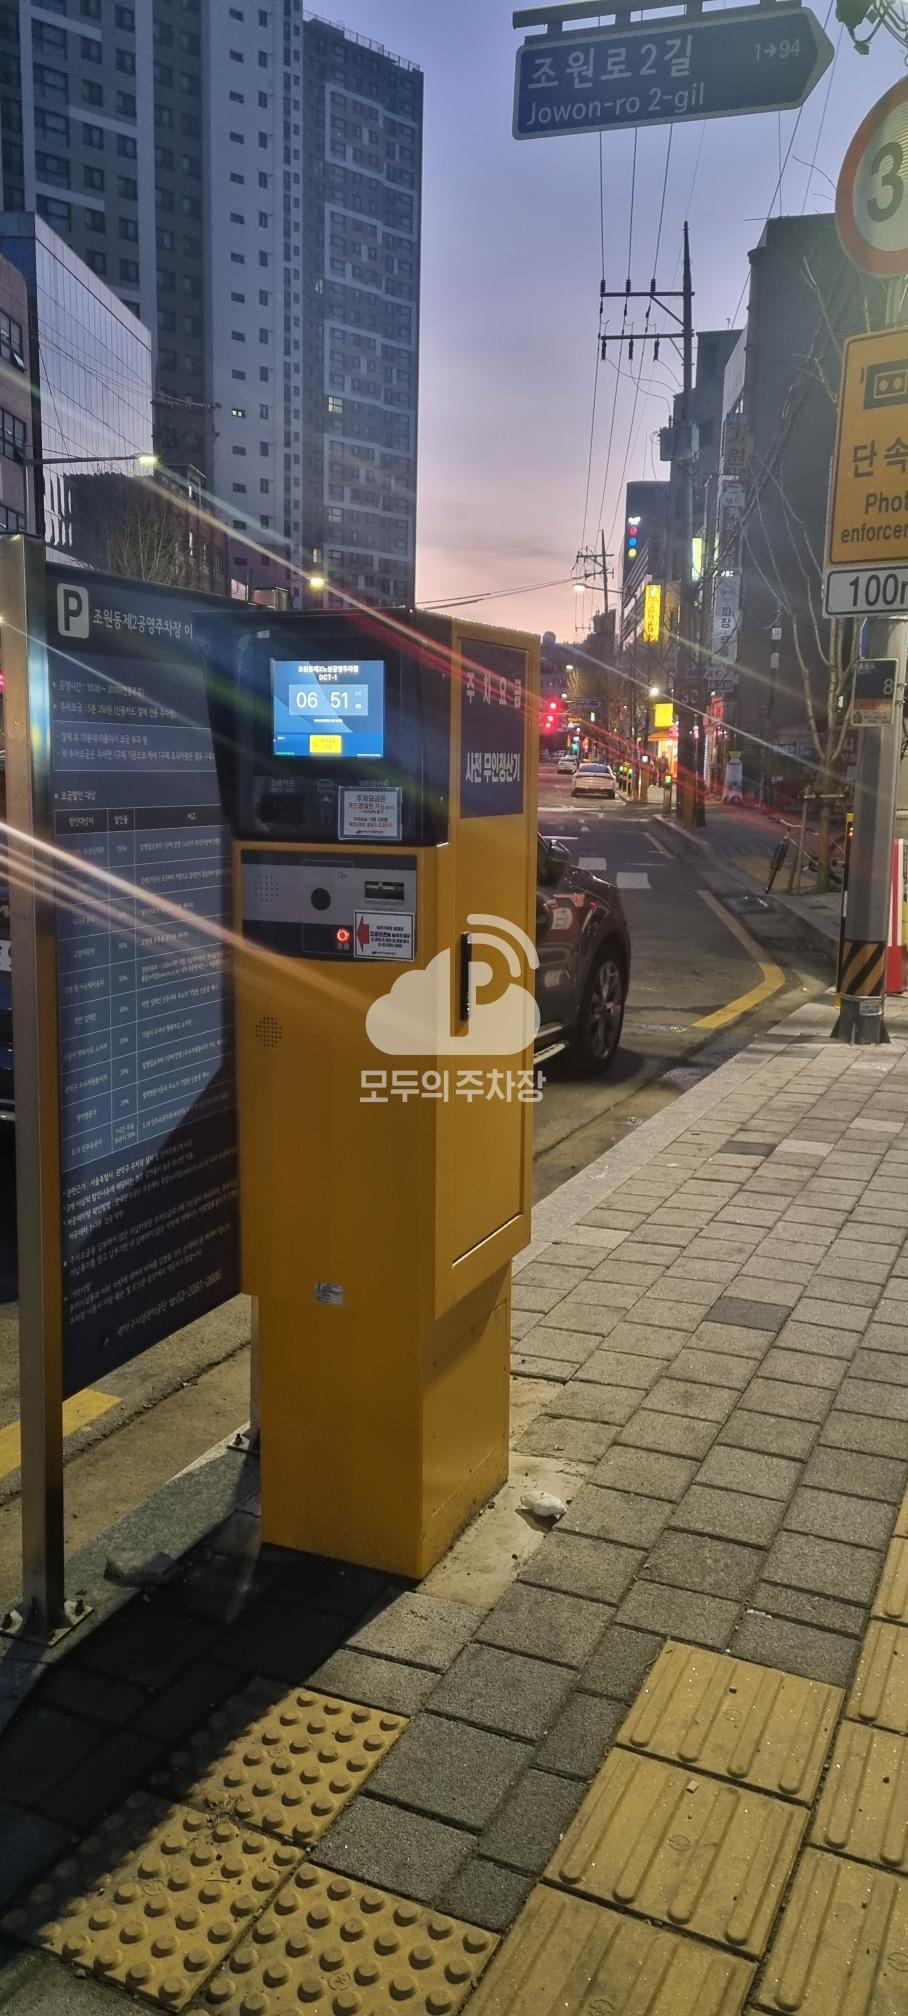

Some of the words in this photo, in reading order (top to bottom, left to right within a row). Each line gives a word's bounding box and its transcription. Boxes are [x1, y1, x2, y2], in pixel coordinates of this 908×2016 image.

[527, 93, 640, 126] Jowon-ro
[648, 82, 704, 117] 2-gil
[63, 589, 82, 632] P
[93, 608, 181, 638] 조원동제2공영주차장
[296, 691, 318, 708] 06
[330, 691, 348, 708] 51
[466, 671, 522, 709] 주차요금
[466, 752, 482, 783] 사전
[483, 752, 521, 783] 무인정산기
